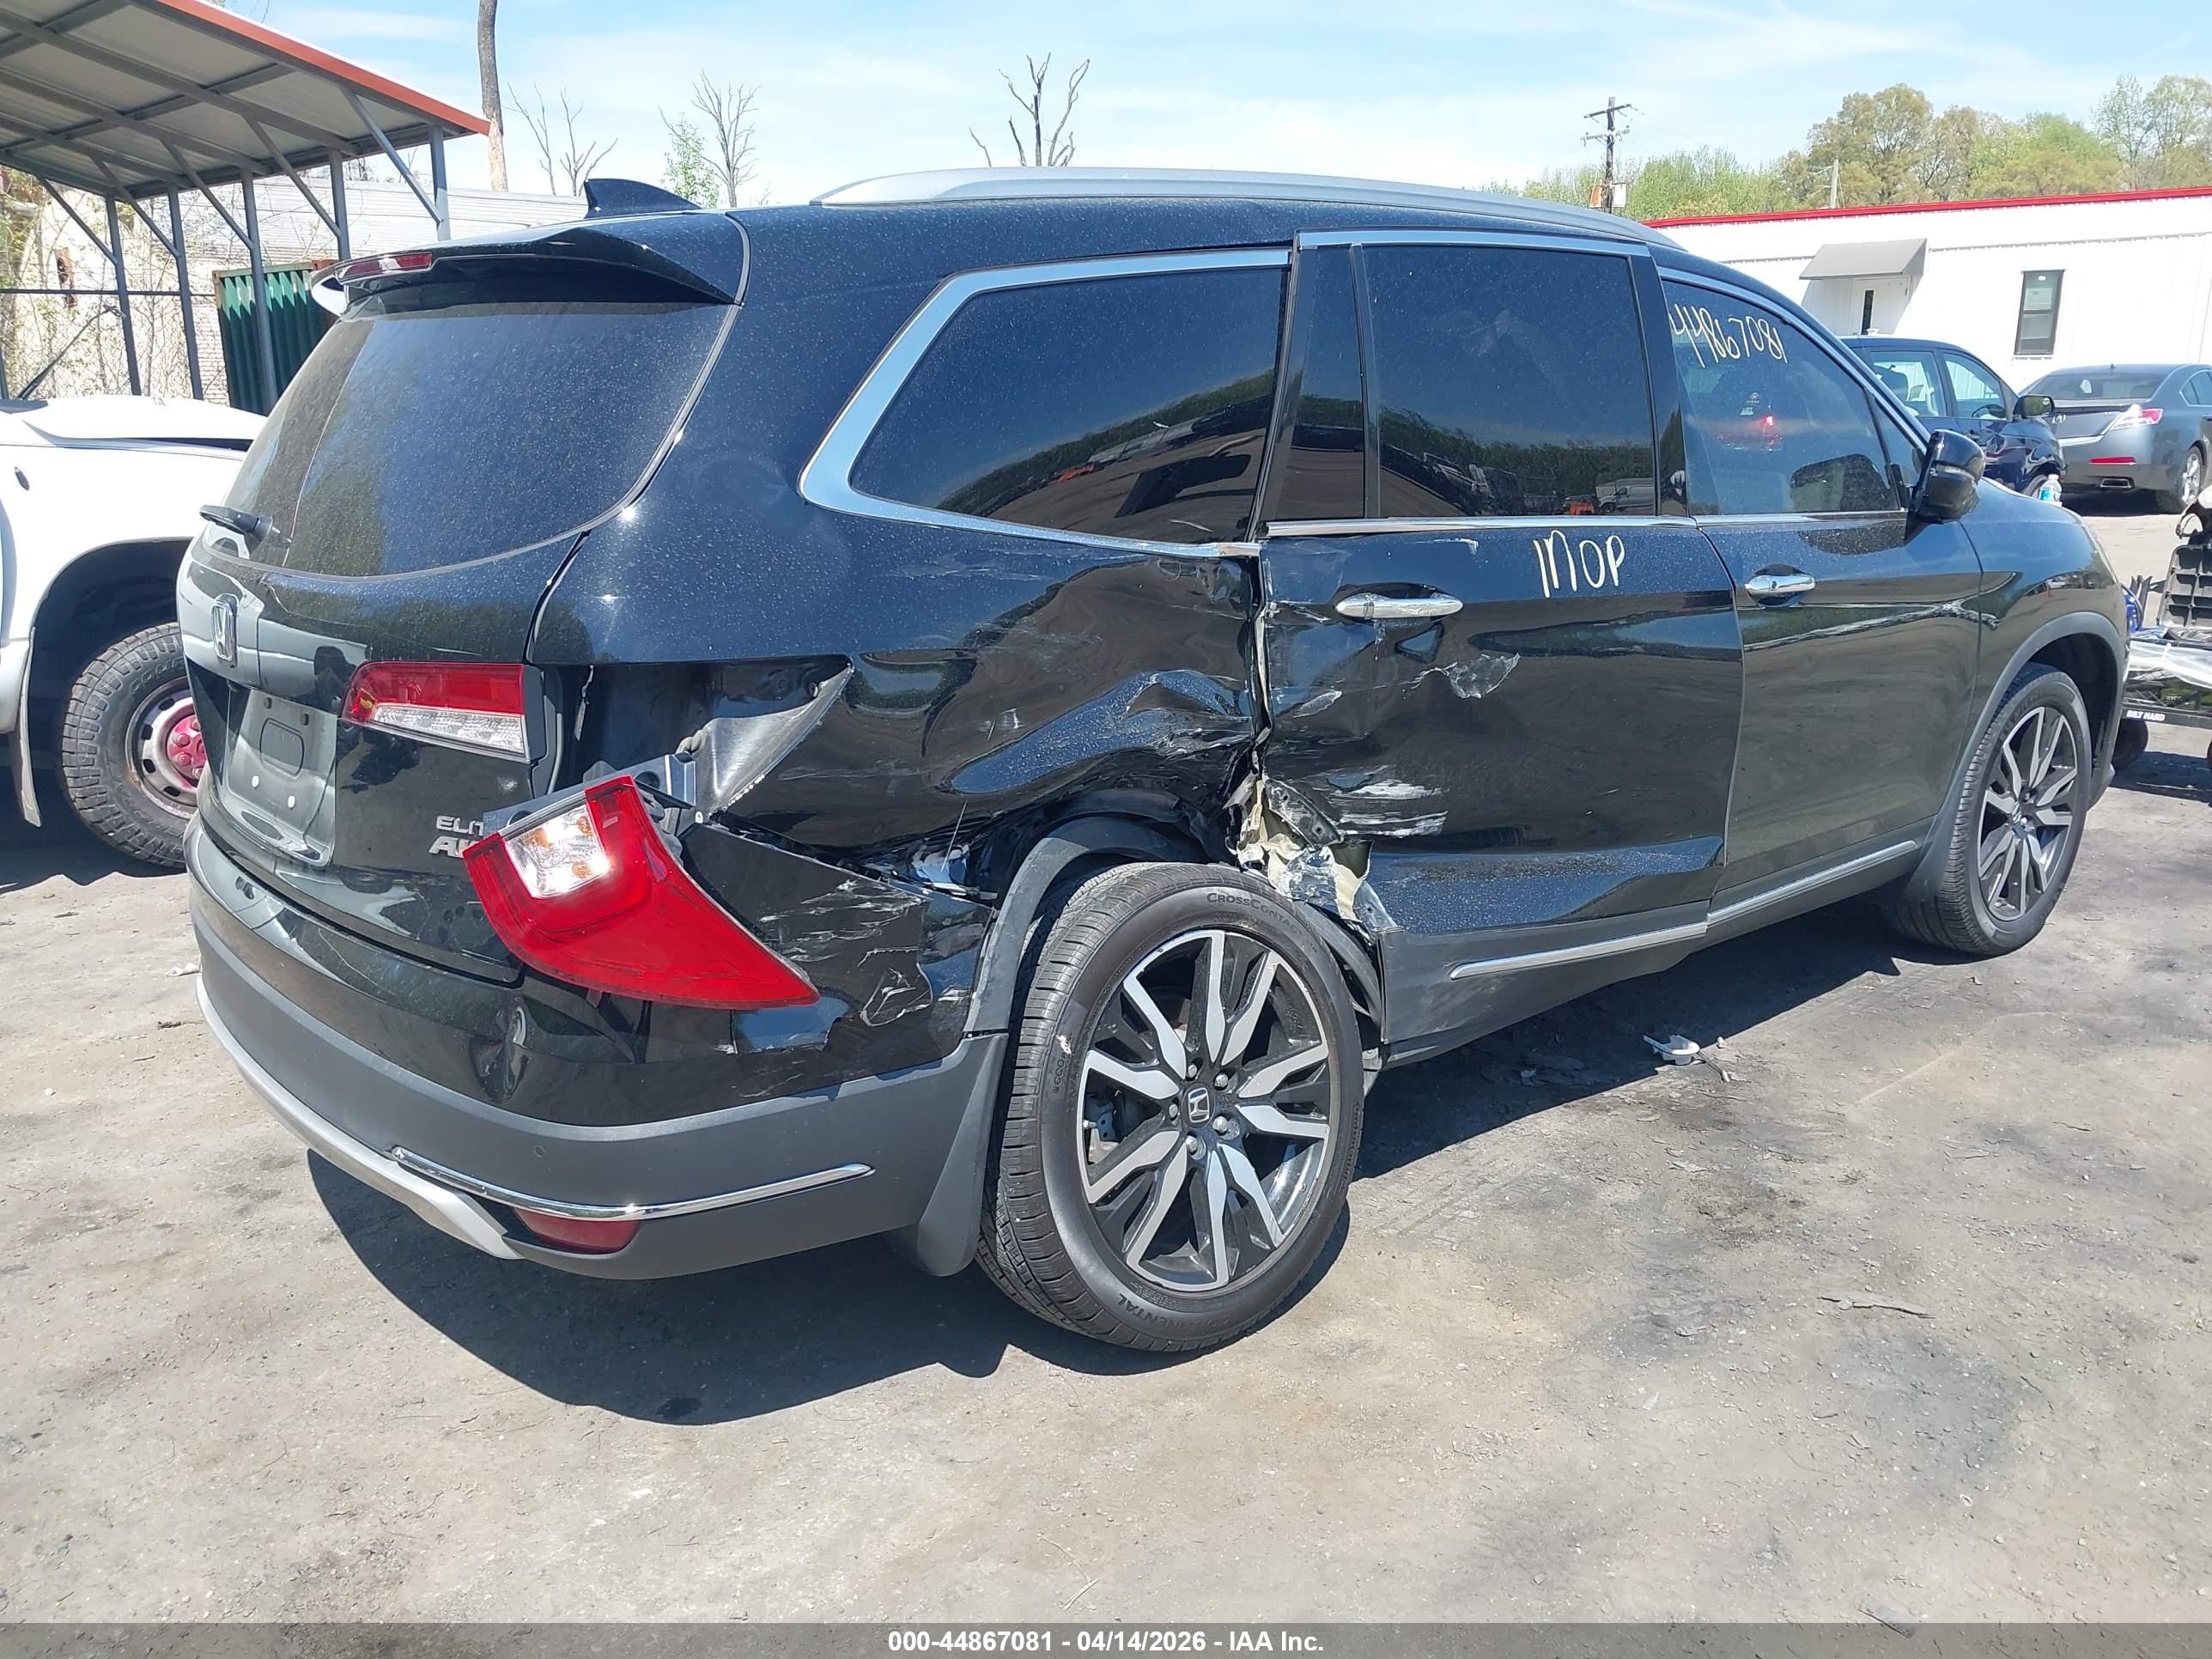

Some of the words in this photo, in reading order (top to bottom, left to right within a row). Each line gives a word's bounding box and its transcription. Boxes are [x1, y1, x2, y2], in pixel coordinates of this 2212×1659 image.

[1668, 302, 1788, 369] 44867081
[2126, 709, 2144, 719] BILT
[2143, 712, 2166, 721] HARD
[436, 815, 484, 836] ELIT
